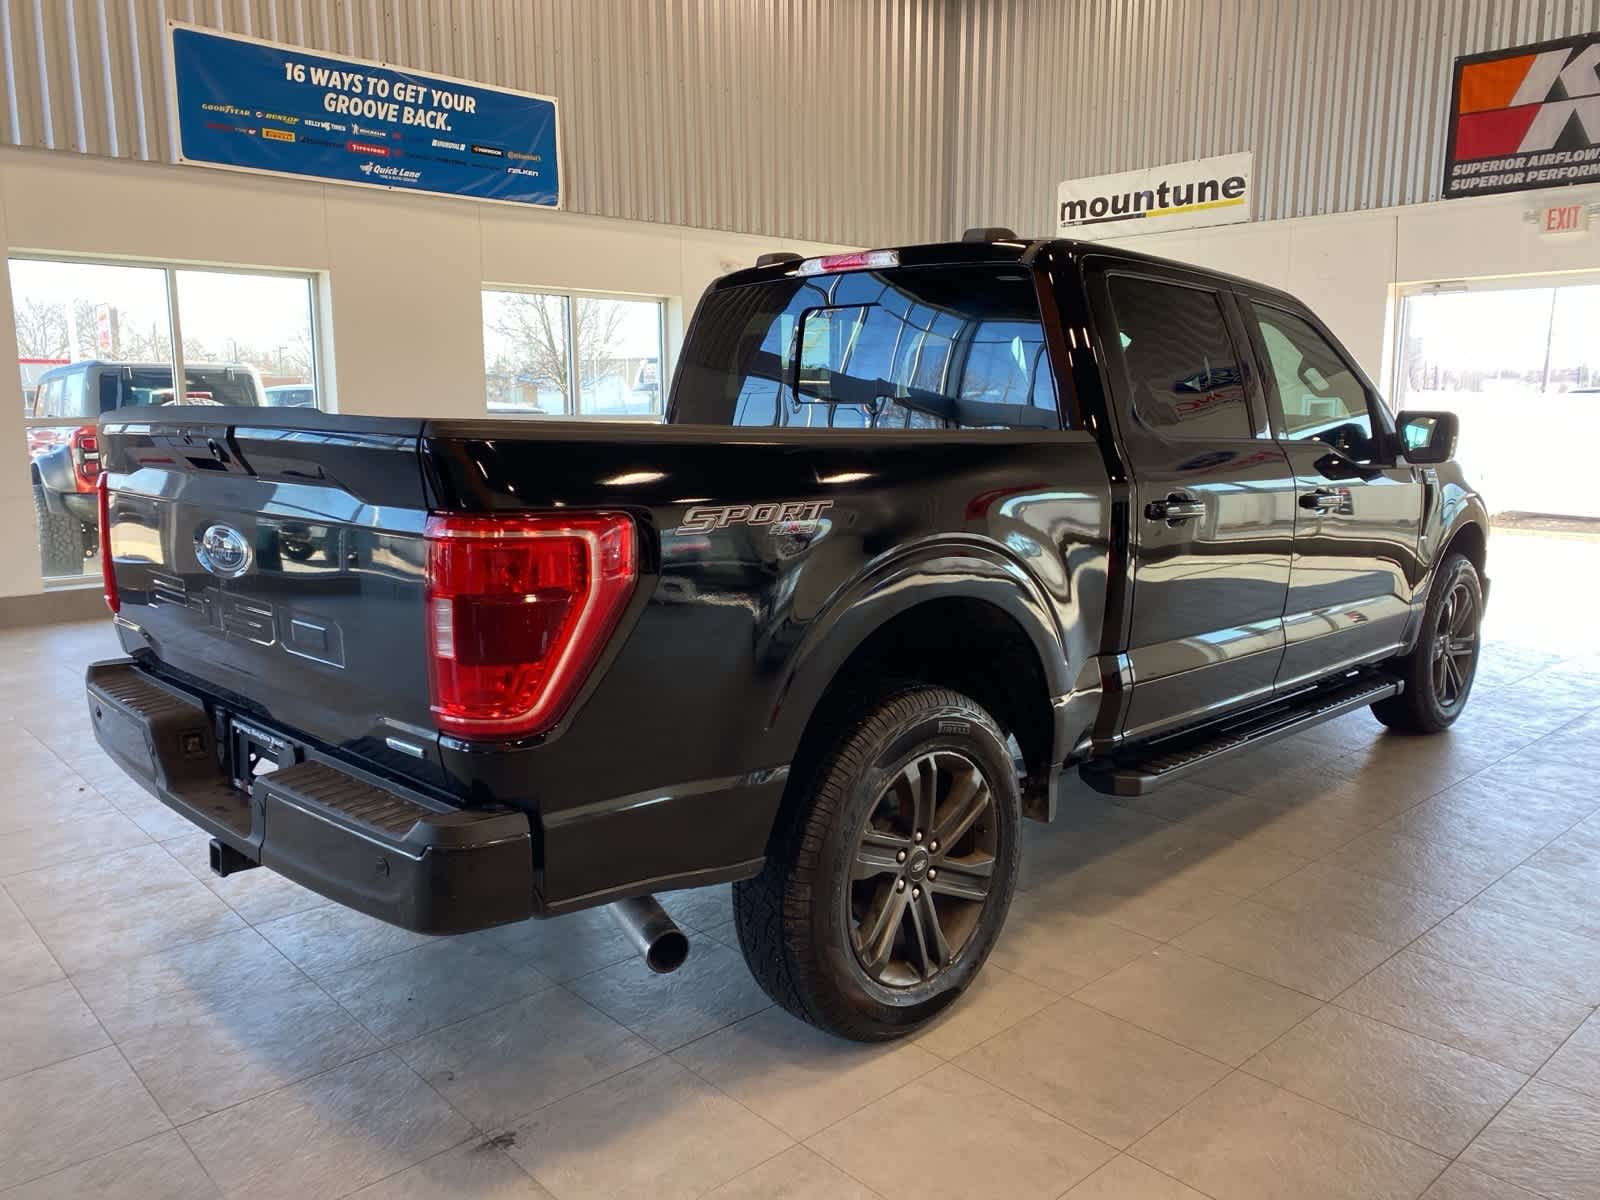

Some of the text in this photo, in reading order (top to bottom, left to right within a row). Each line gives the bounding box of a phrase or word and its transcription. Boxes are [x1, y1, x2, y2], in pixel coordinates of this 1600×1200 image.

[285, 63, 476, 114] 16 WAYS TO GET YOUR
[201, 103, 250, 117] GOODYEAR
[266, 113, 300, 125] DUNLOP
[324, 92, 452, 132] GROOVE BACK.
[304, 119, 321, 129] KELLY
[373, 164, 399, 175] Quick
[399, 168, 422, 178] Lane
[1452, 157, 1526, 176] SUPERIOR
[1450, 172, 1525, 190] SUPERIOR
[1060, 175, 1246, 221] mountune
[1546, 206, 1582, 231] EXIT
[674, 499, 834, 536] SPORT
[938, 719, 971, 735] PIRELLI
